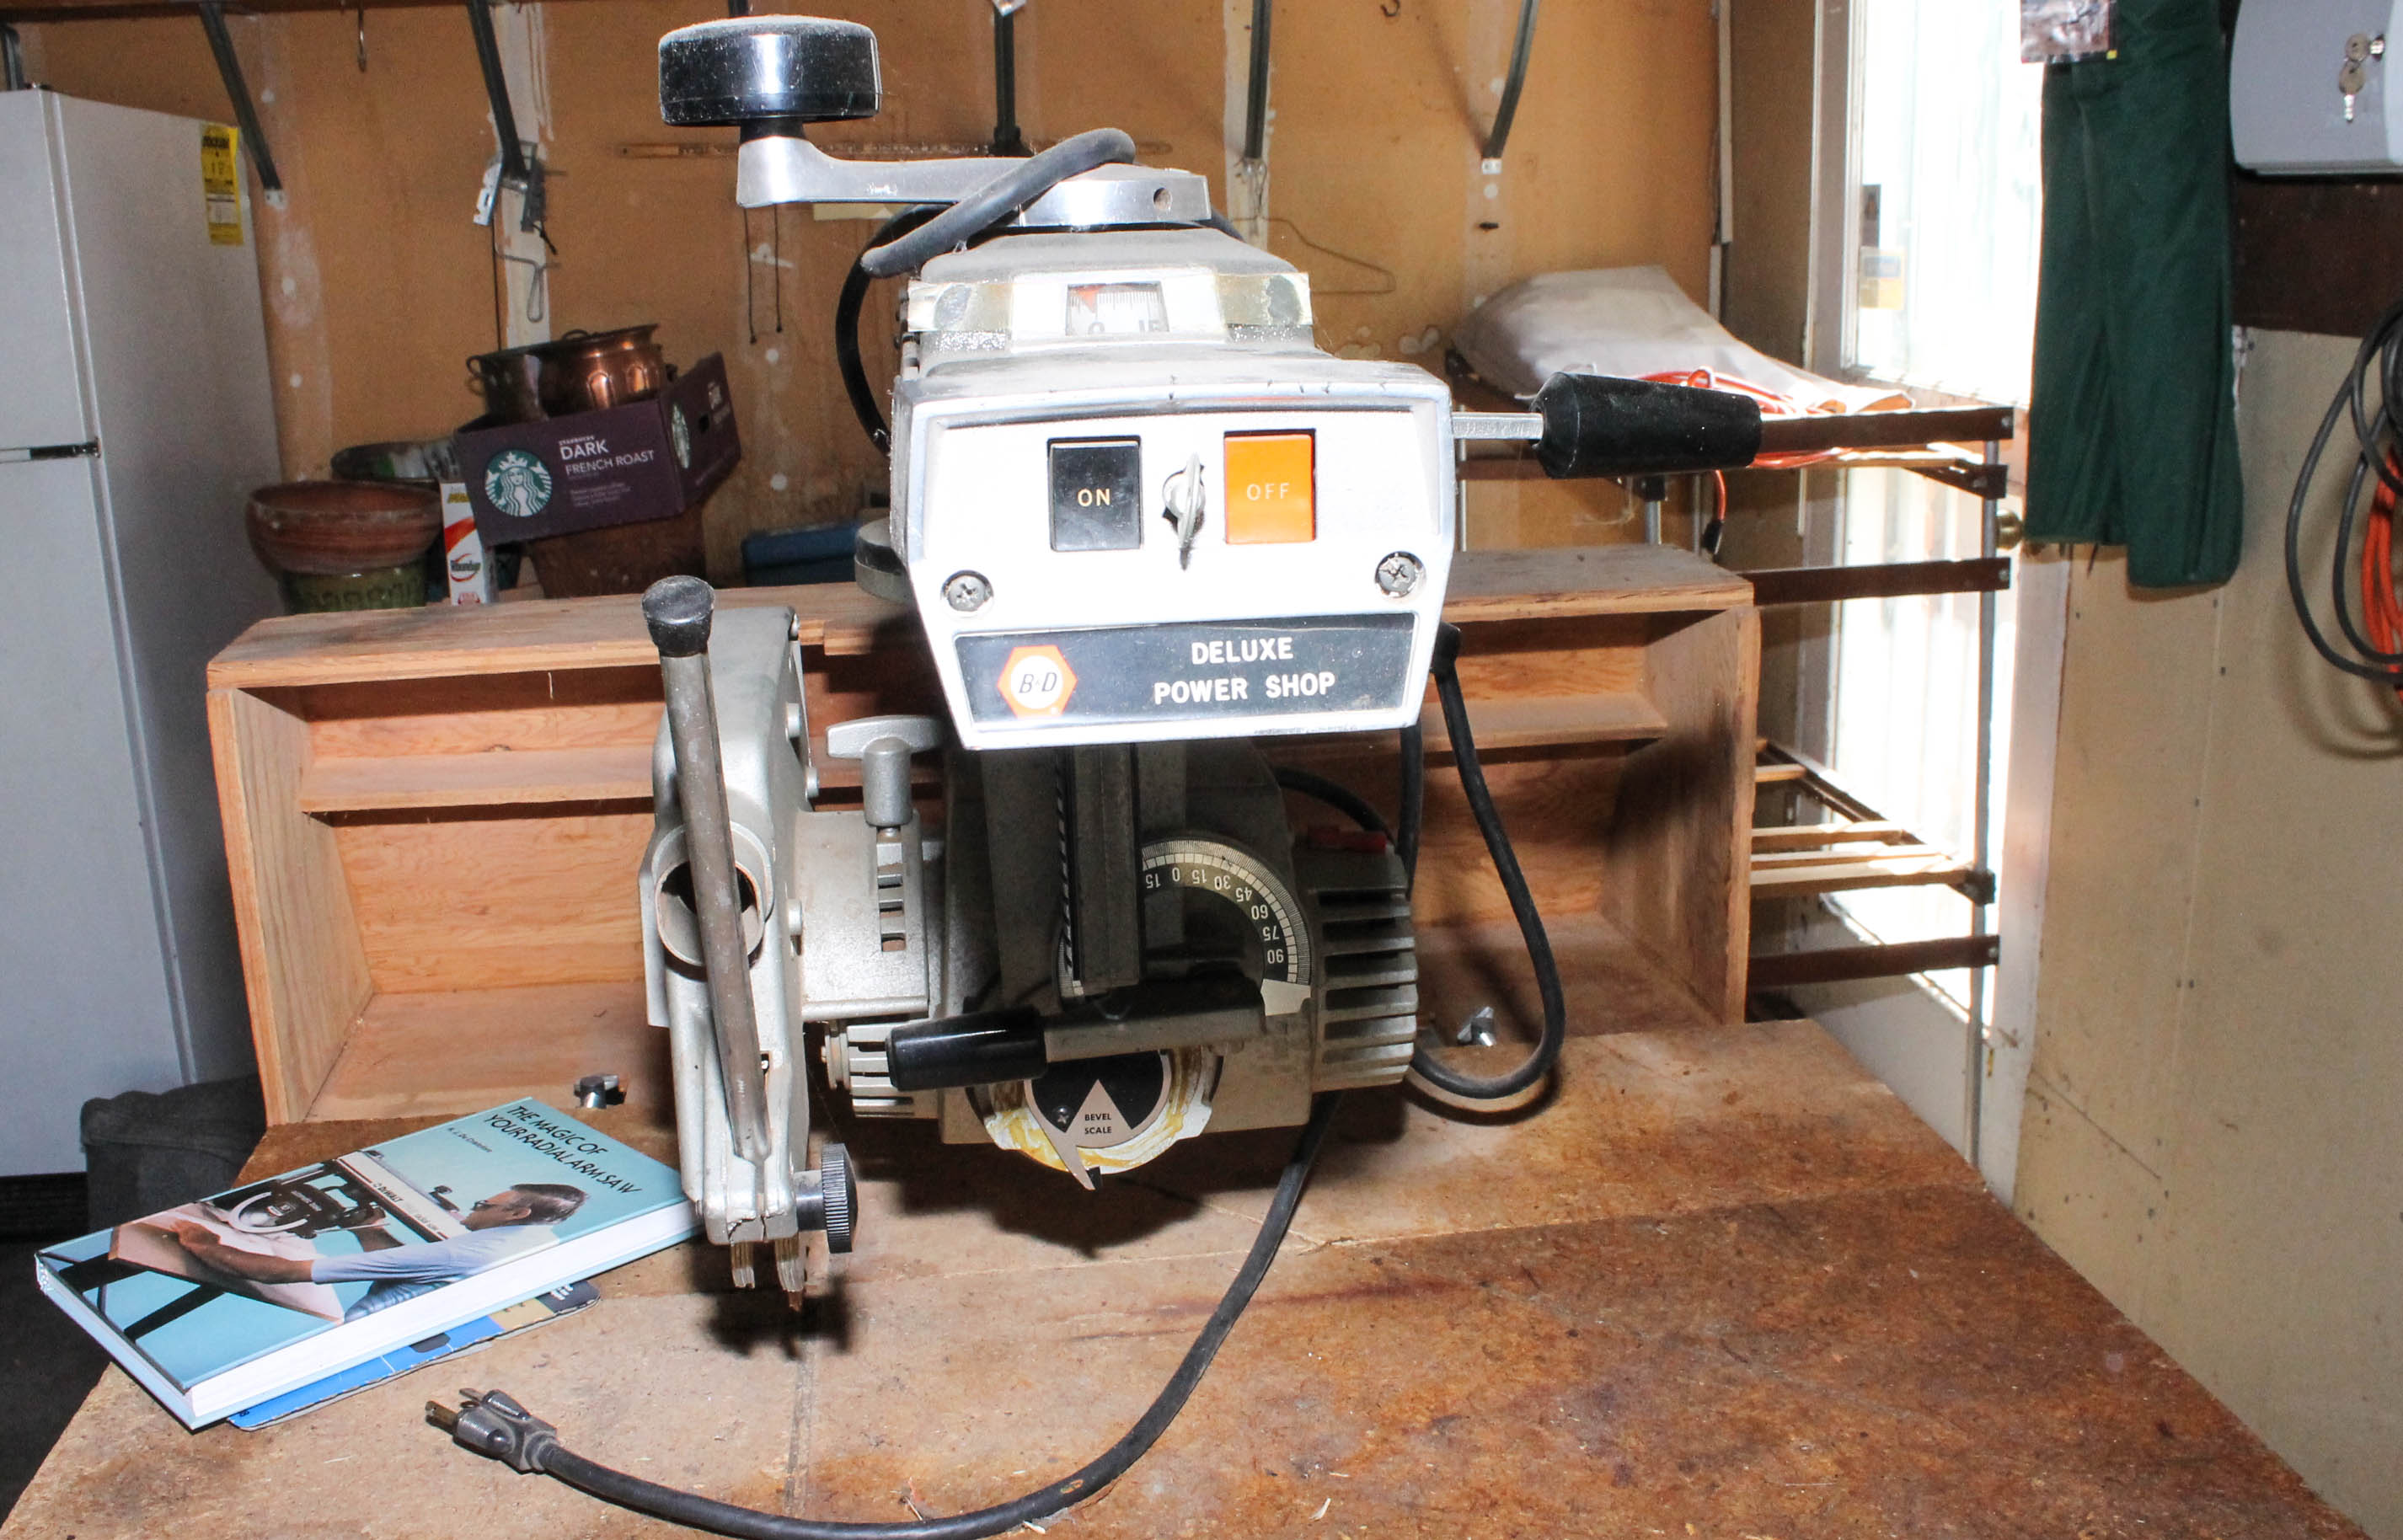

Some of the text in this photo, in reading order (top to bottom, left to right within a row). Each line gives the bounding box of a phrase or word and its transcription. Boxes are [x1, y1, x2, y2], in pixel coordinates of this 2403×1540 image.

[559, 439, 609, 461] DARK
[565, 450, 654, 476] FRENCH ROAST
[1077, 488, 1111, 507] ON
[1245, 482, 1290, 501] OFF
[1191, 637, 1294, 665] DELUXE
[1153, 671, 1336, 704] POWER SHOP
[1192, 869, 1207, 884] 15
[1214, 874, 1231, 890] 30
[1235, 887, 1253, 902] 45
[1262, 925, 1280, 941] 75
[507, 1105, 608, 1155] THE MAGIC OF
[1084, 1113, 1111, 1121] BEVEL
[1084, 1126, 1112, 1135] SCALE
[484, 1114, 642, 1194] YOUR RADIAL ARM SAW
